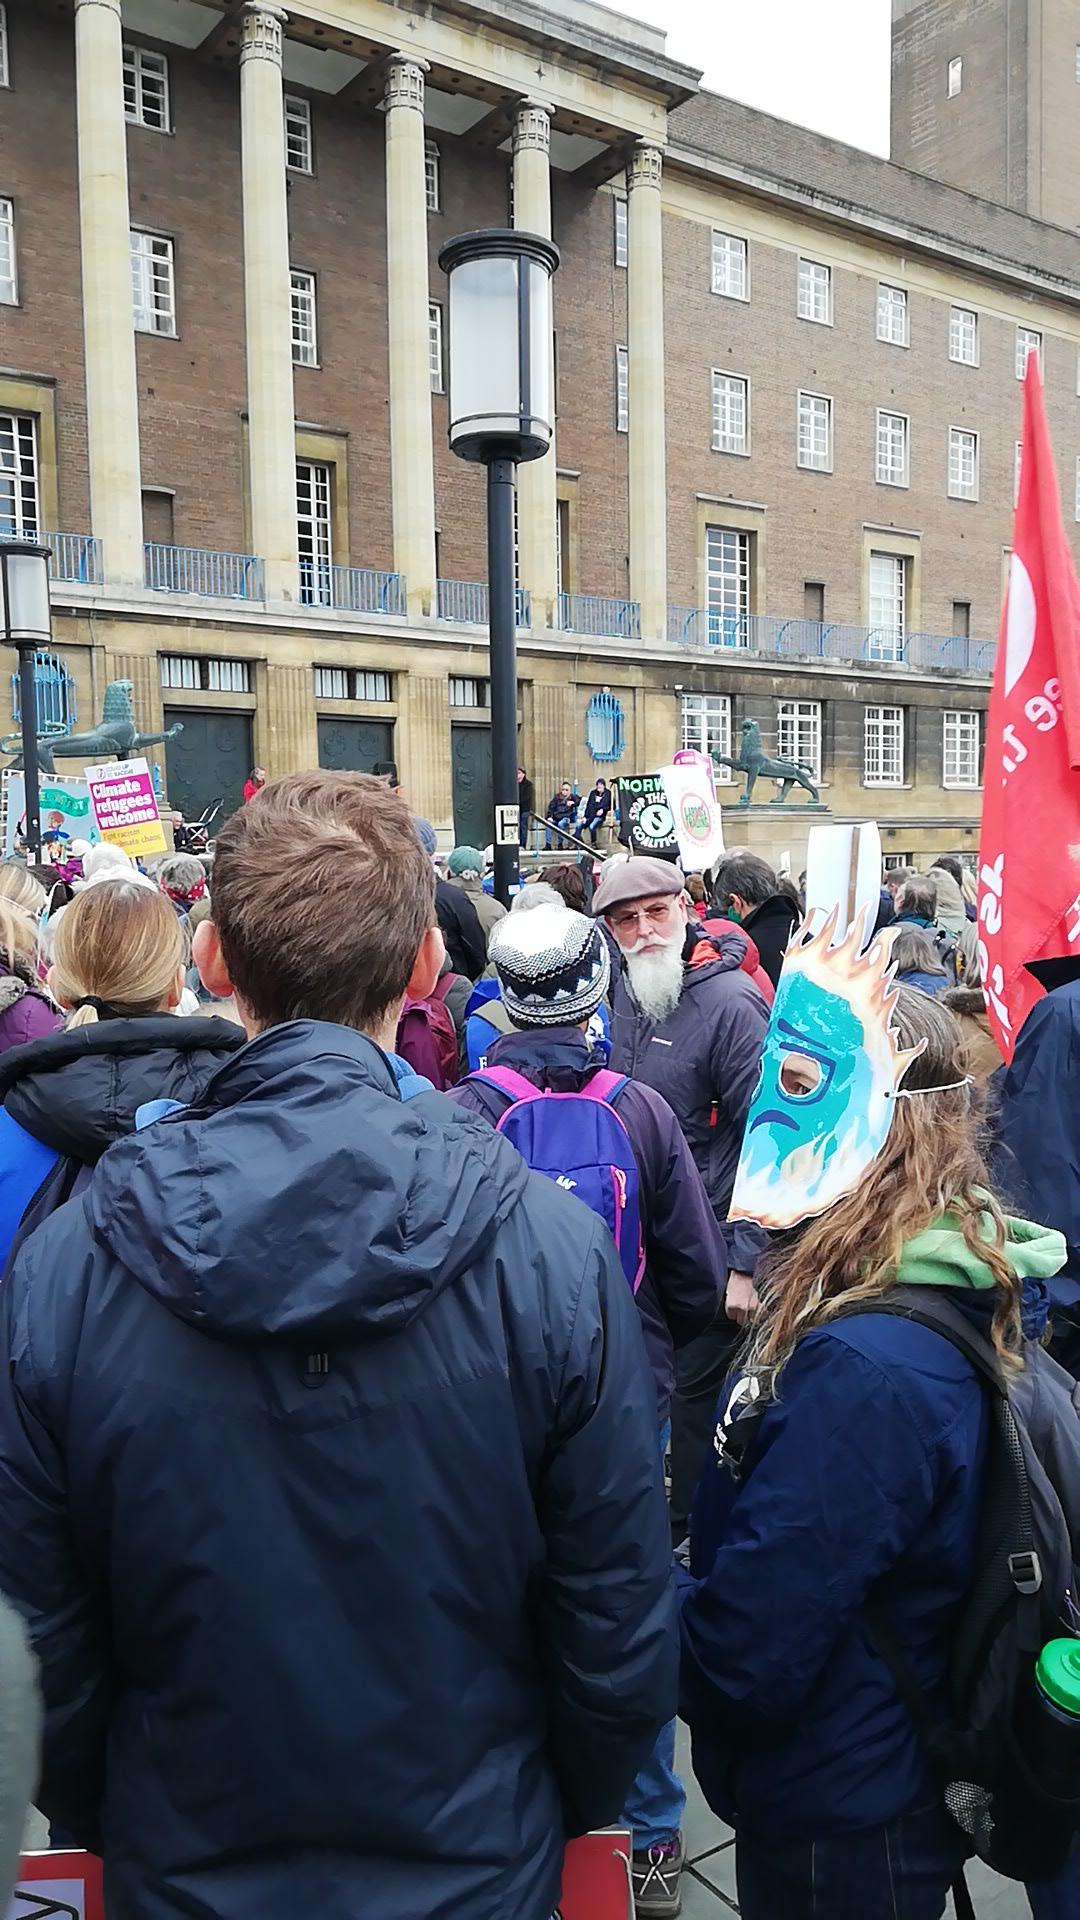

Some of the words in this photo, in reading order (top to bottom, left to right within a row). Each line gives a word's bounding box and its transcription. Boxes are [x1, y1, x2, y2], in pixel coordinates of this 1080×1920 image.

[92, 779, 142, 800] Climate
[619, 777, 665, 792] NORW
[96, 793, 153, 814] refugees
[629, 797, 647, 821] STOP
[645, 792, 667, 805] THE
[98, 808, 157, 828] welcome
[632, 825, 679, 848] COALITIO
